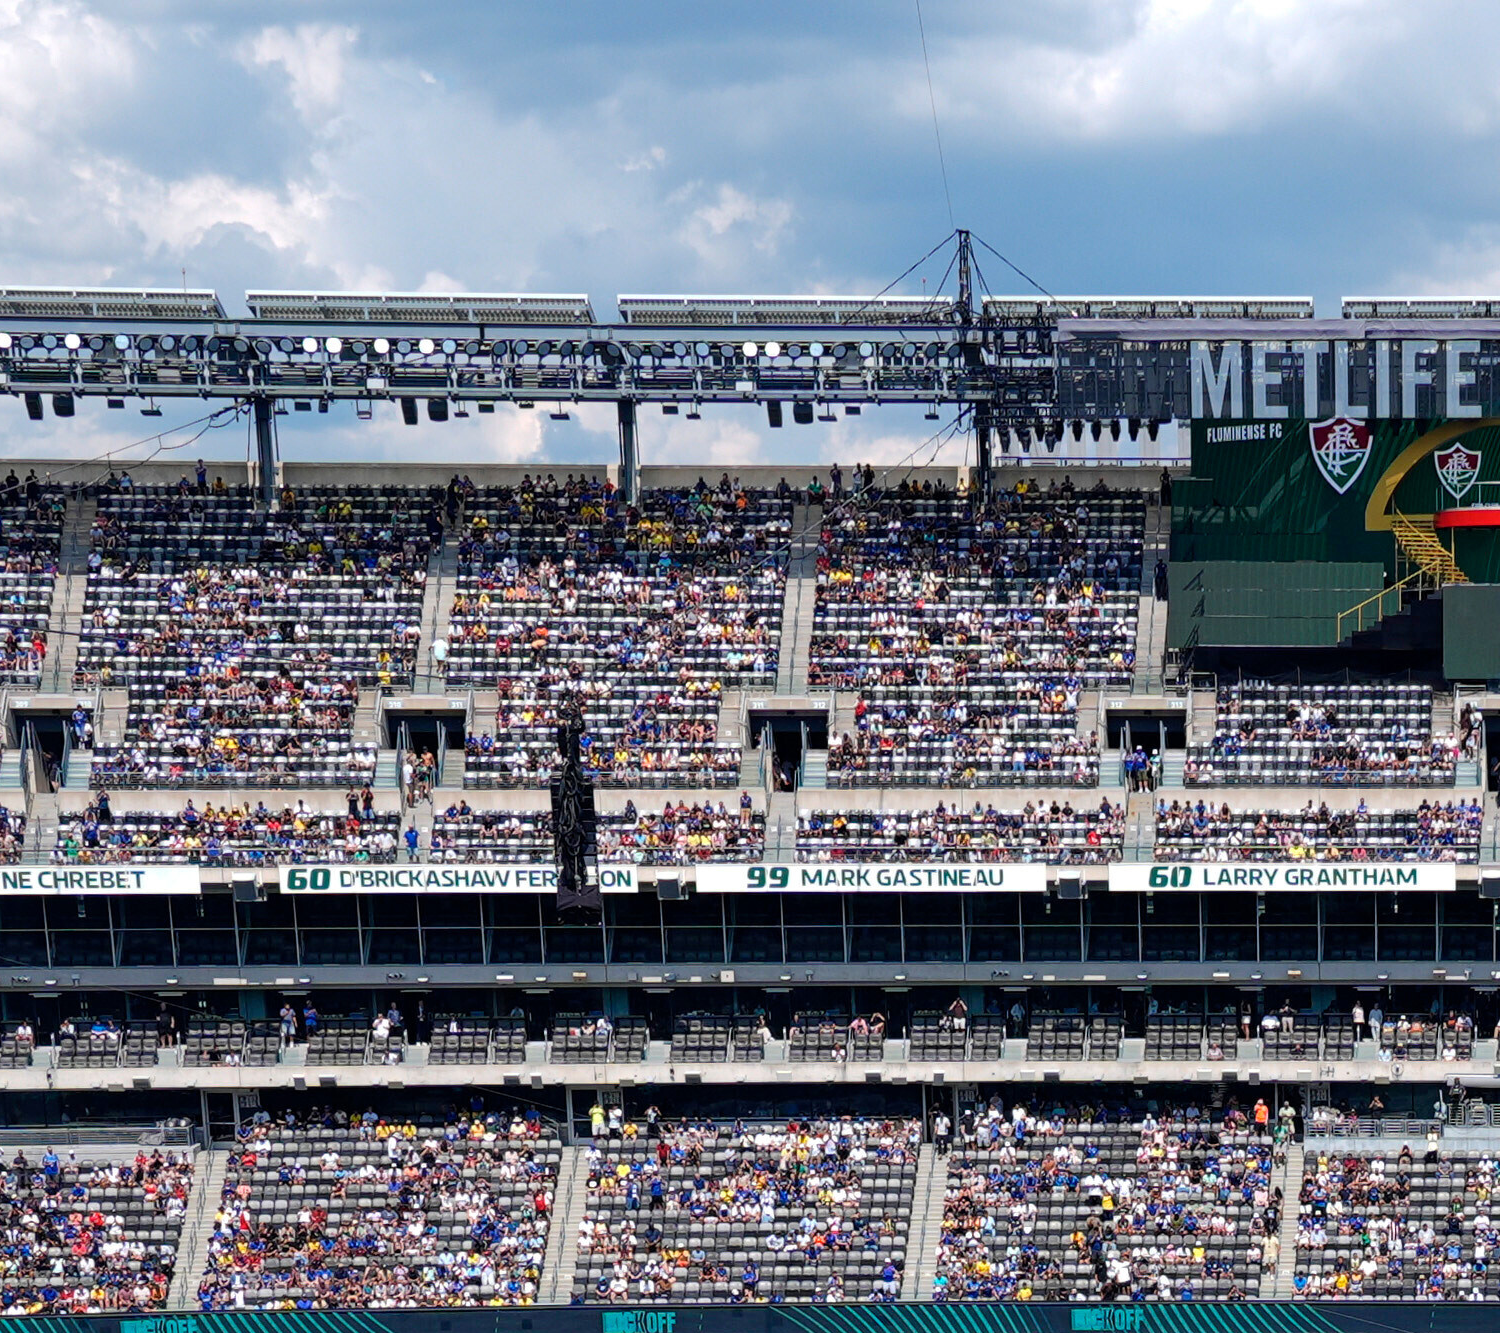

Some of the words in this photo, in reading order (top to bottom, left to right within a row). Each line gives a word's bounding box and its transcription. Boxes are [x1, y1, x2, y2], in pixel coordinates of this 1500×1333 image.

[1190, 339, 1482, 419] METLIFE
[1206, 424, 1266, 443] FLUMINENSE
[1269, 423, 1283, 439] FC
[38, 871, 145, 890] CHREBET
[287, 868, 331, 891] 60
[340, 869, 510, 889] D'BRICKASHAW
[516, 869, 632, 888] FERON
[747, 867, 789, 889] 99
[801, 869, 871, 886] MARK
[876, 868, 1004, 887] GASTINEAU
[1148, 866, 1192, 888] 60
[1203, 868, 1279, 886] LARRY
[1284, 868, 1417, 886] GRANTHAM
[646, 1312, 676, 1333] OFF
[1114, 1309, 1143, 1331] OFF
